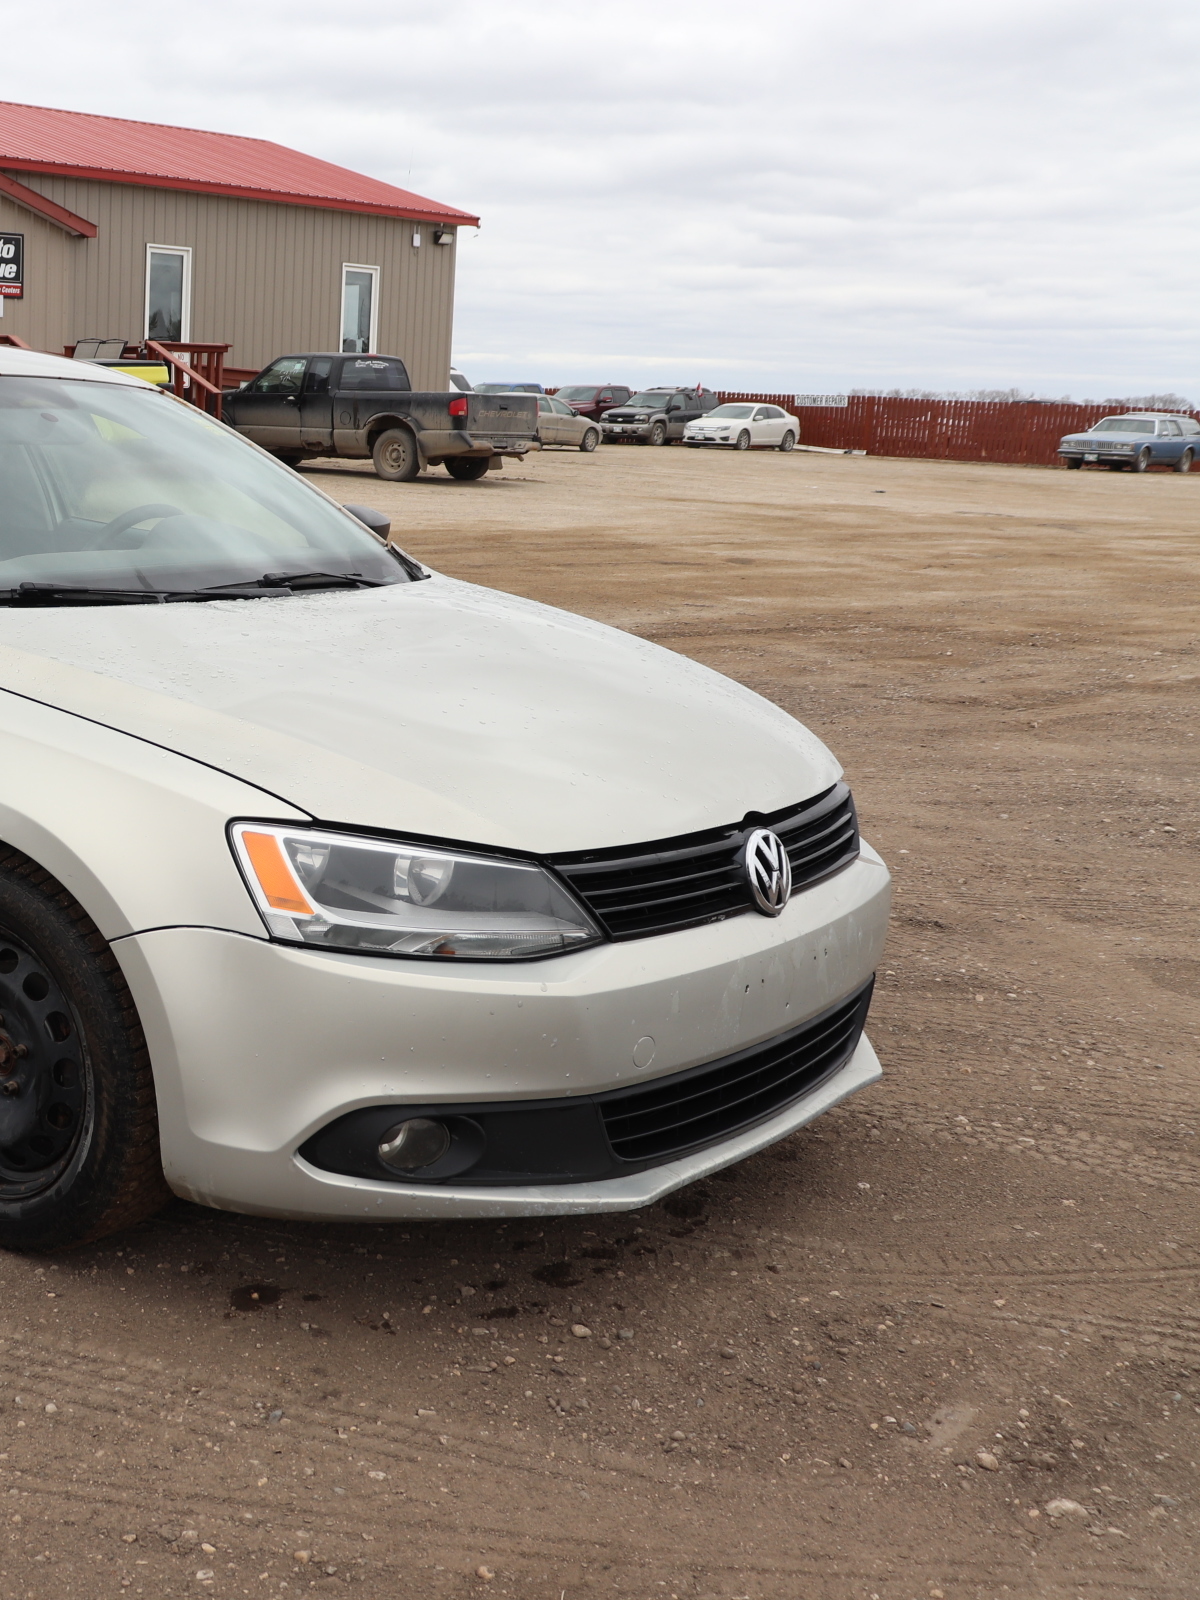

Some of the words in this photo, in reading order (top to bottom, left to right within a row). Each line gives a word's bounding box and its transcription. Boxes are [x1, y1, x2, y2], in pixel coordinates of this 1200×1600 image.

[2, 286, 21, 294] Centers
[796, 396, 823, 406] CUSTOMER
[825, 396, 846, 406] REPAIRS
[479, 410, 529, 418] CHEVROLET
